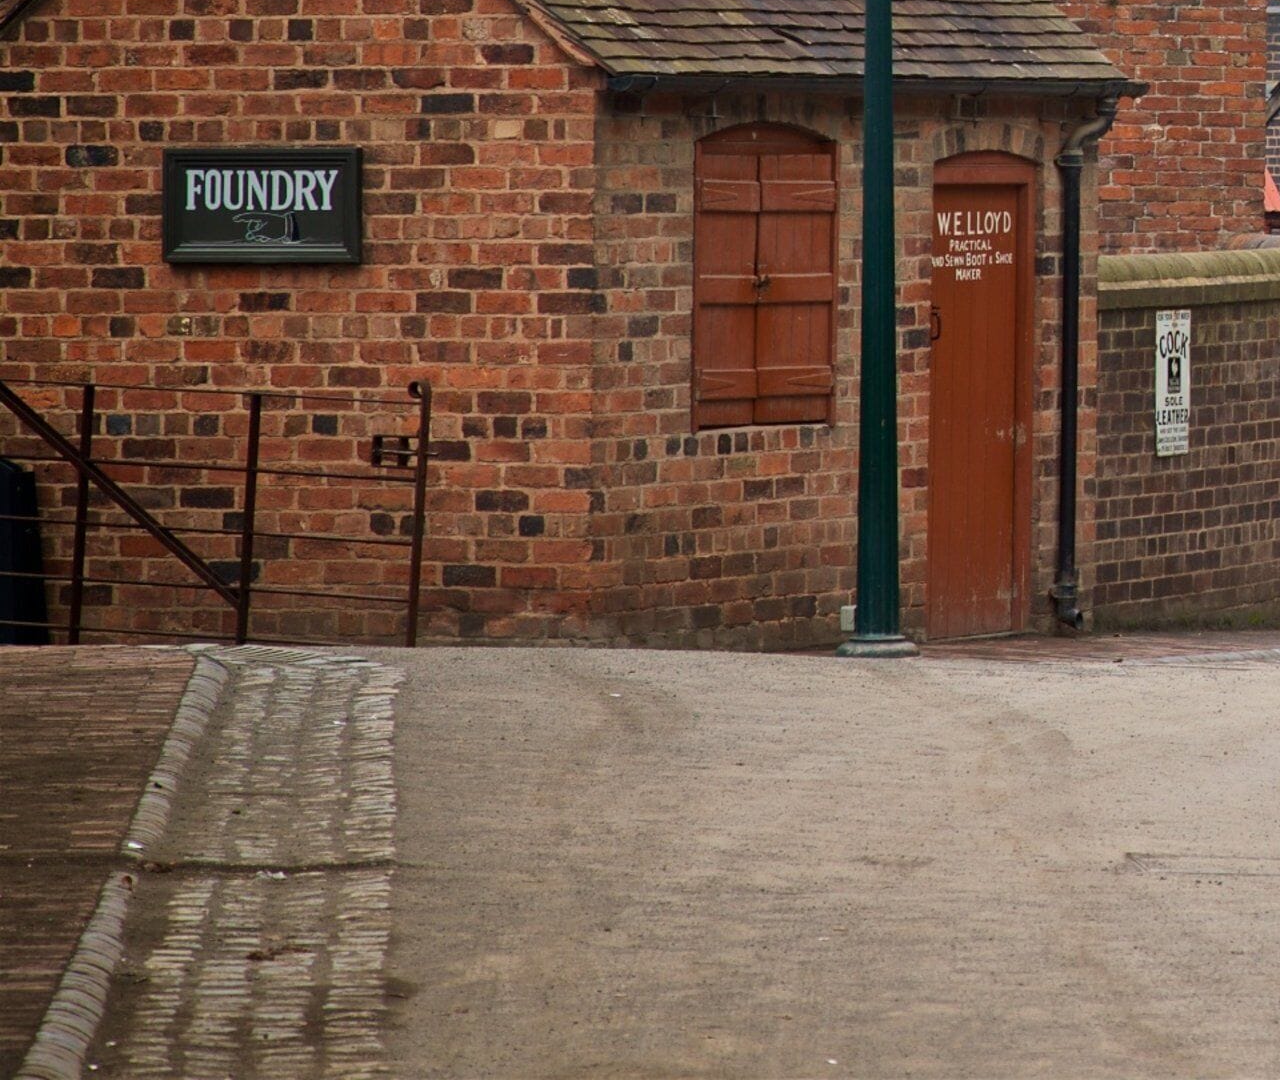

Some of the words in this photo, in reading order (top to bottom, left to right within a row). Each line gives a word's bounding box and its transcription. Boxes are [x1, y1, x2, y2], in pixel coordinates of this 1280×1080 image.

[185, 169, 338, 211] FOUNDRY
[949, 239, 992, 252] PRACTICAL
[966, 252, 987, 266] BOOT
[955, 268, 981, 280] MAKER
[1159, 330, 1188, 359] COCK
[1165, 395, 1183, 407] SOLE
[1156, 408, 1188, 425] LEATHER
